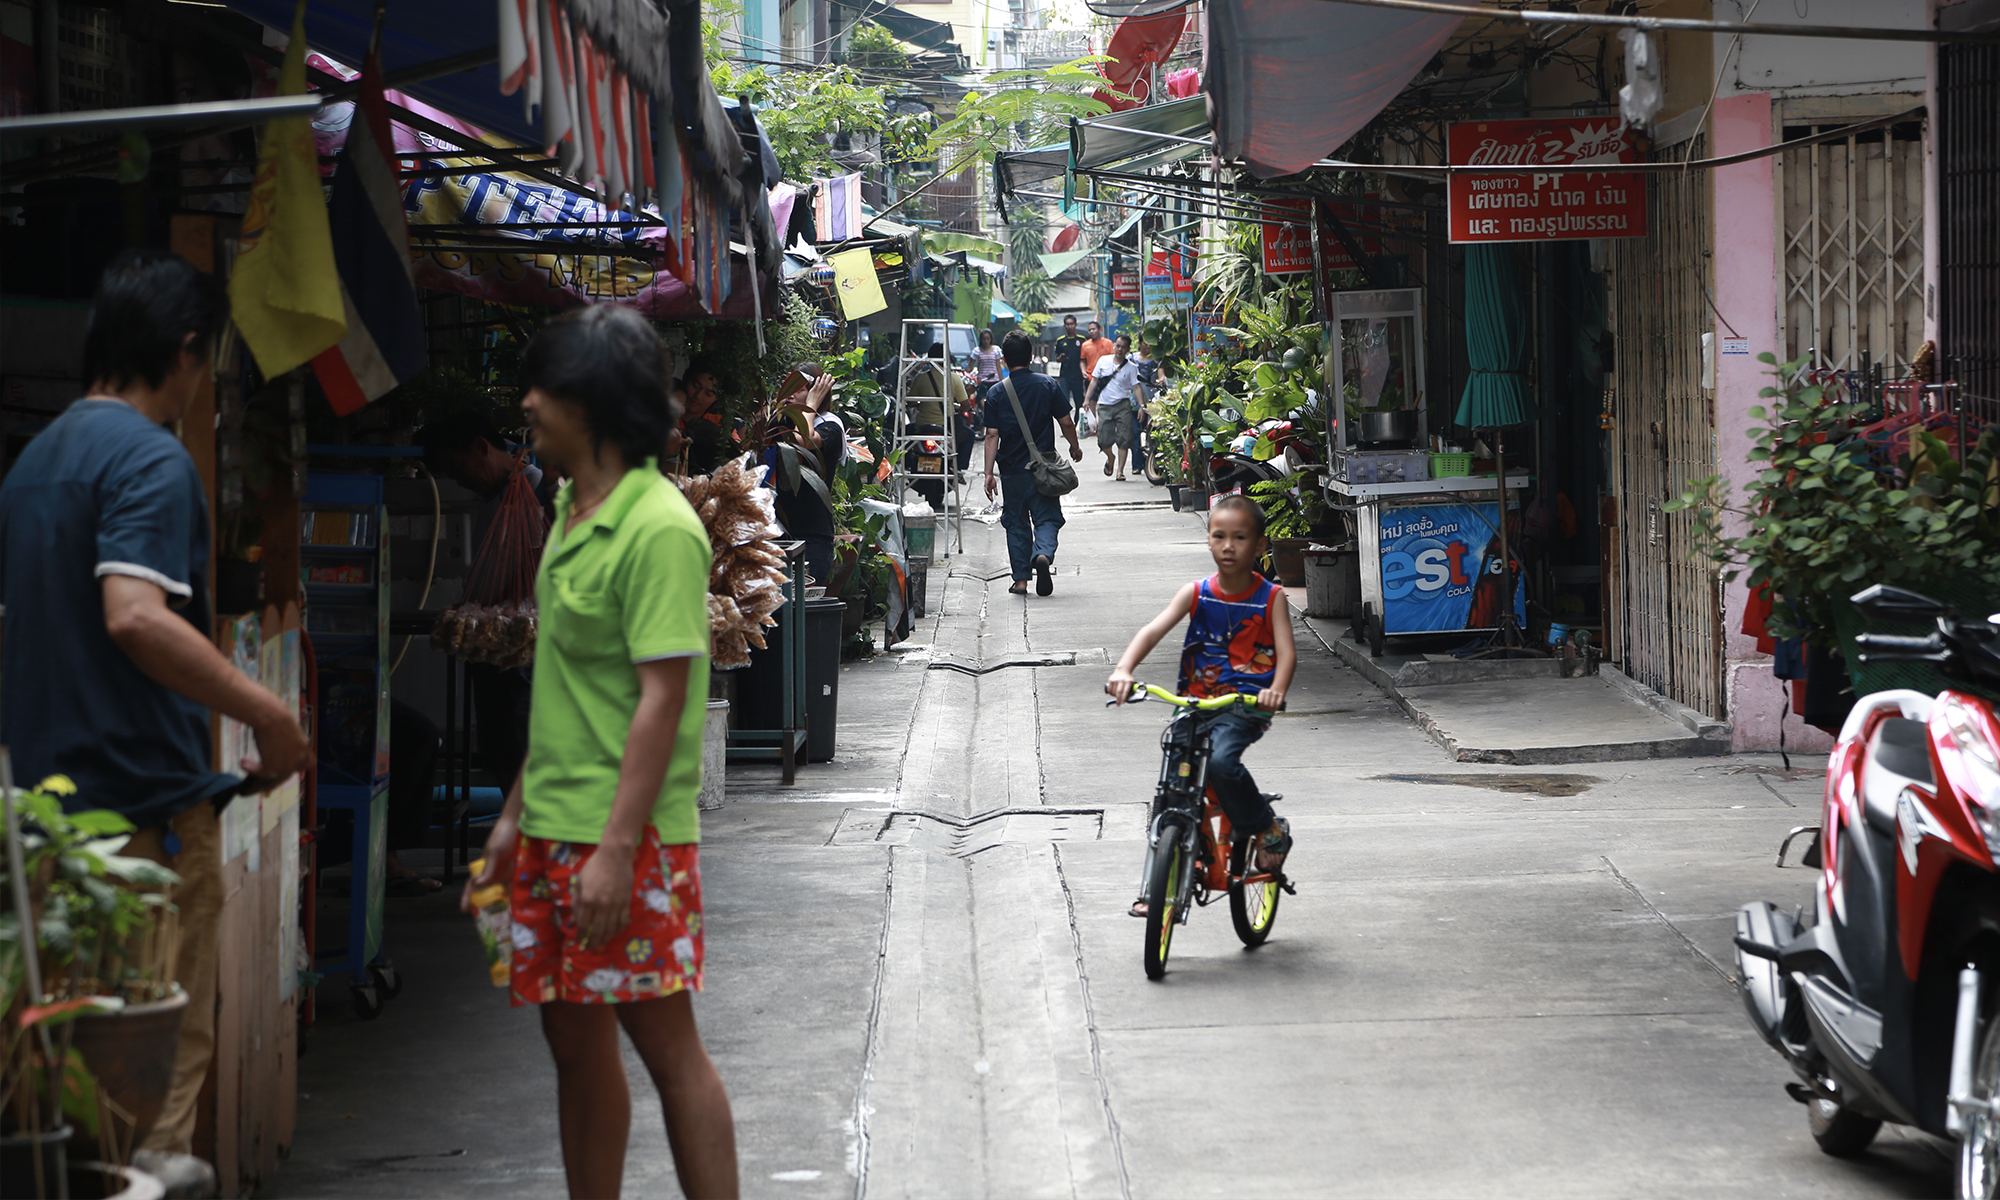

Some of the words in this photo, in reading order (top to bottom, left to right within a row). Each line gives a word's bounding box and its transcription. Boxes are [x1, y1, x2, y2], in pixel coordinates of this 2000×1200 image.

[1542, 139, 1567, 163] 2
[1471, 177, 1520, 190] ทองขาว
[1533, 173, 1564, 190] PT
[1468, 191, 1539, 209] เศษทอง
[1549, 190, 1585, 207] นาค
[1595, 185, 1628, 206] เงิน
[1469, 218, 1500, 234] และ
[1510, 211, 1628, 237] ทองรูปพรรณ
[1382, 541, 1468, 600] est
[1446, 585, 1472, 599] COLA
